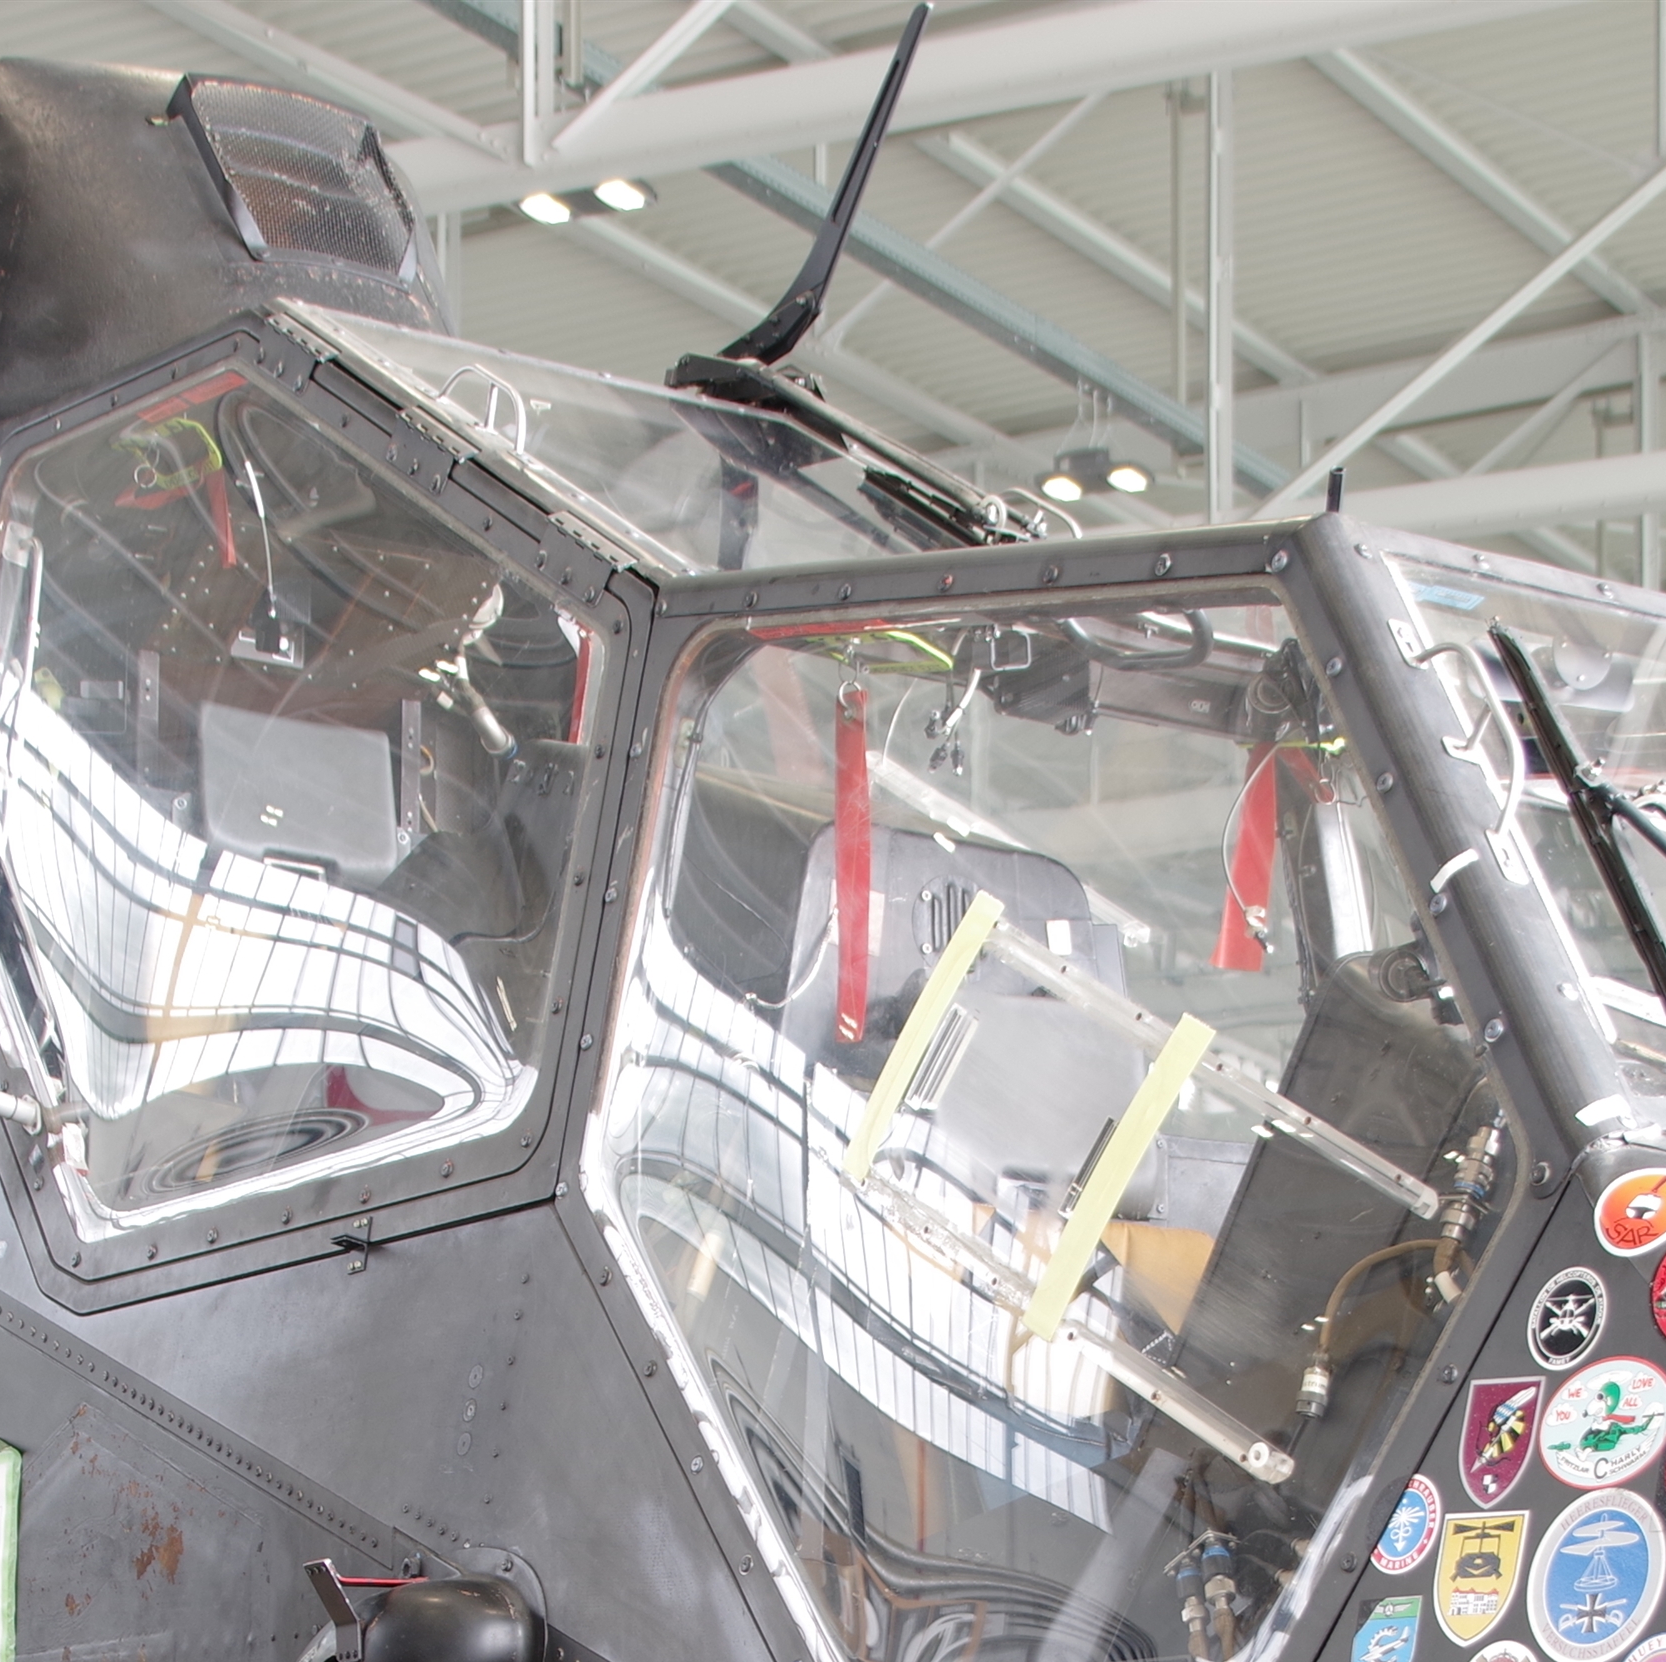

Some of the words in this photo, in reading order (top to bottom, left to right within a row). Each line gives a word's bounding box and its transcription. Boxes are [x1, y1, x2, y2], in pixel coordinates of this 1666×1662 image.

[1605, 1223, 1659, 1246] SAR
[1567, 1388, 1582, 1399] WE
[1632, 1378, 1654, 1390] LOVE
[1622, 1398, 1639, 1408] ALL
[1555, 1409, 1571, 1421] YOU
[1560, 1455, 1591, 1474] FRITZLAR
[1608, 1450, 1649, 1475] SCHWARM
[1560, 1495, 1649, 1531] HEERESFLIEGER
[1379, 1551, 1419, 1571] MARINE
